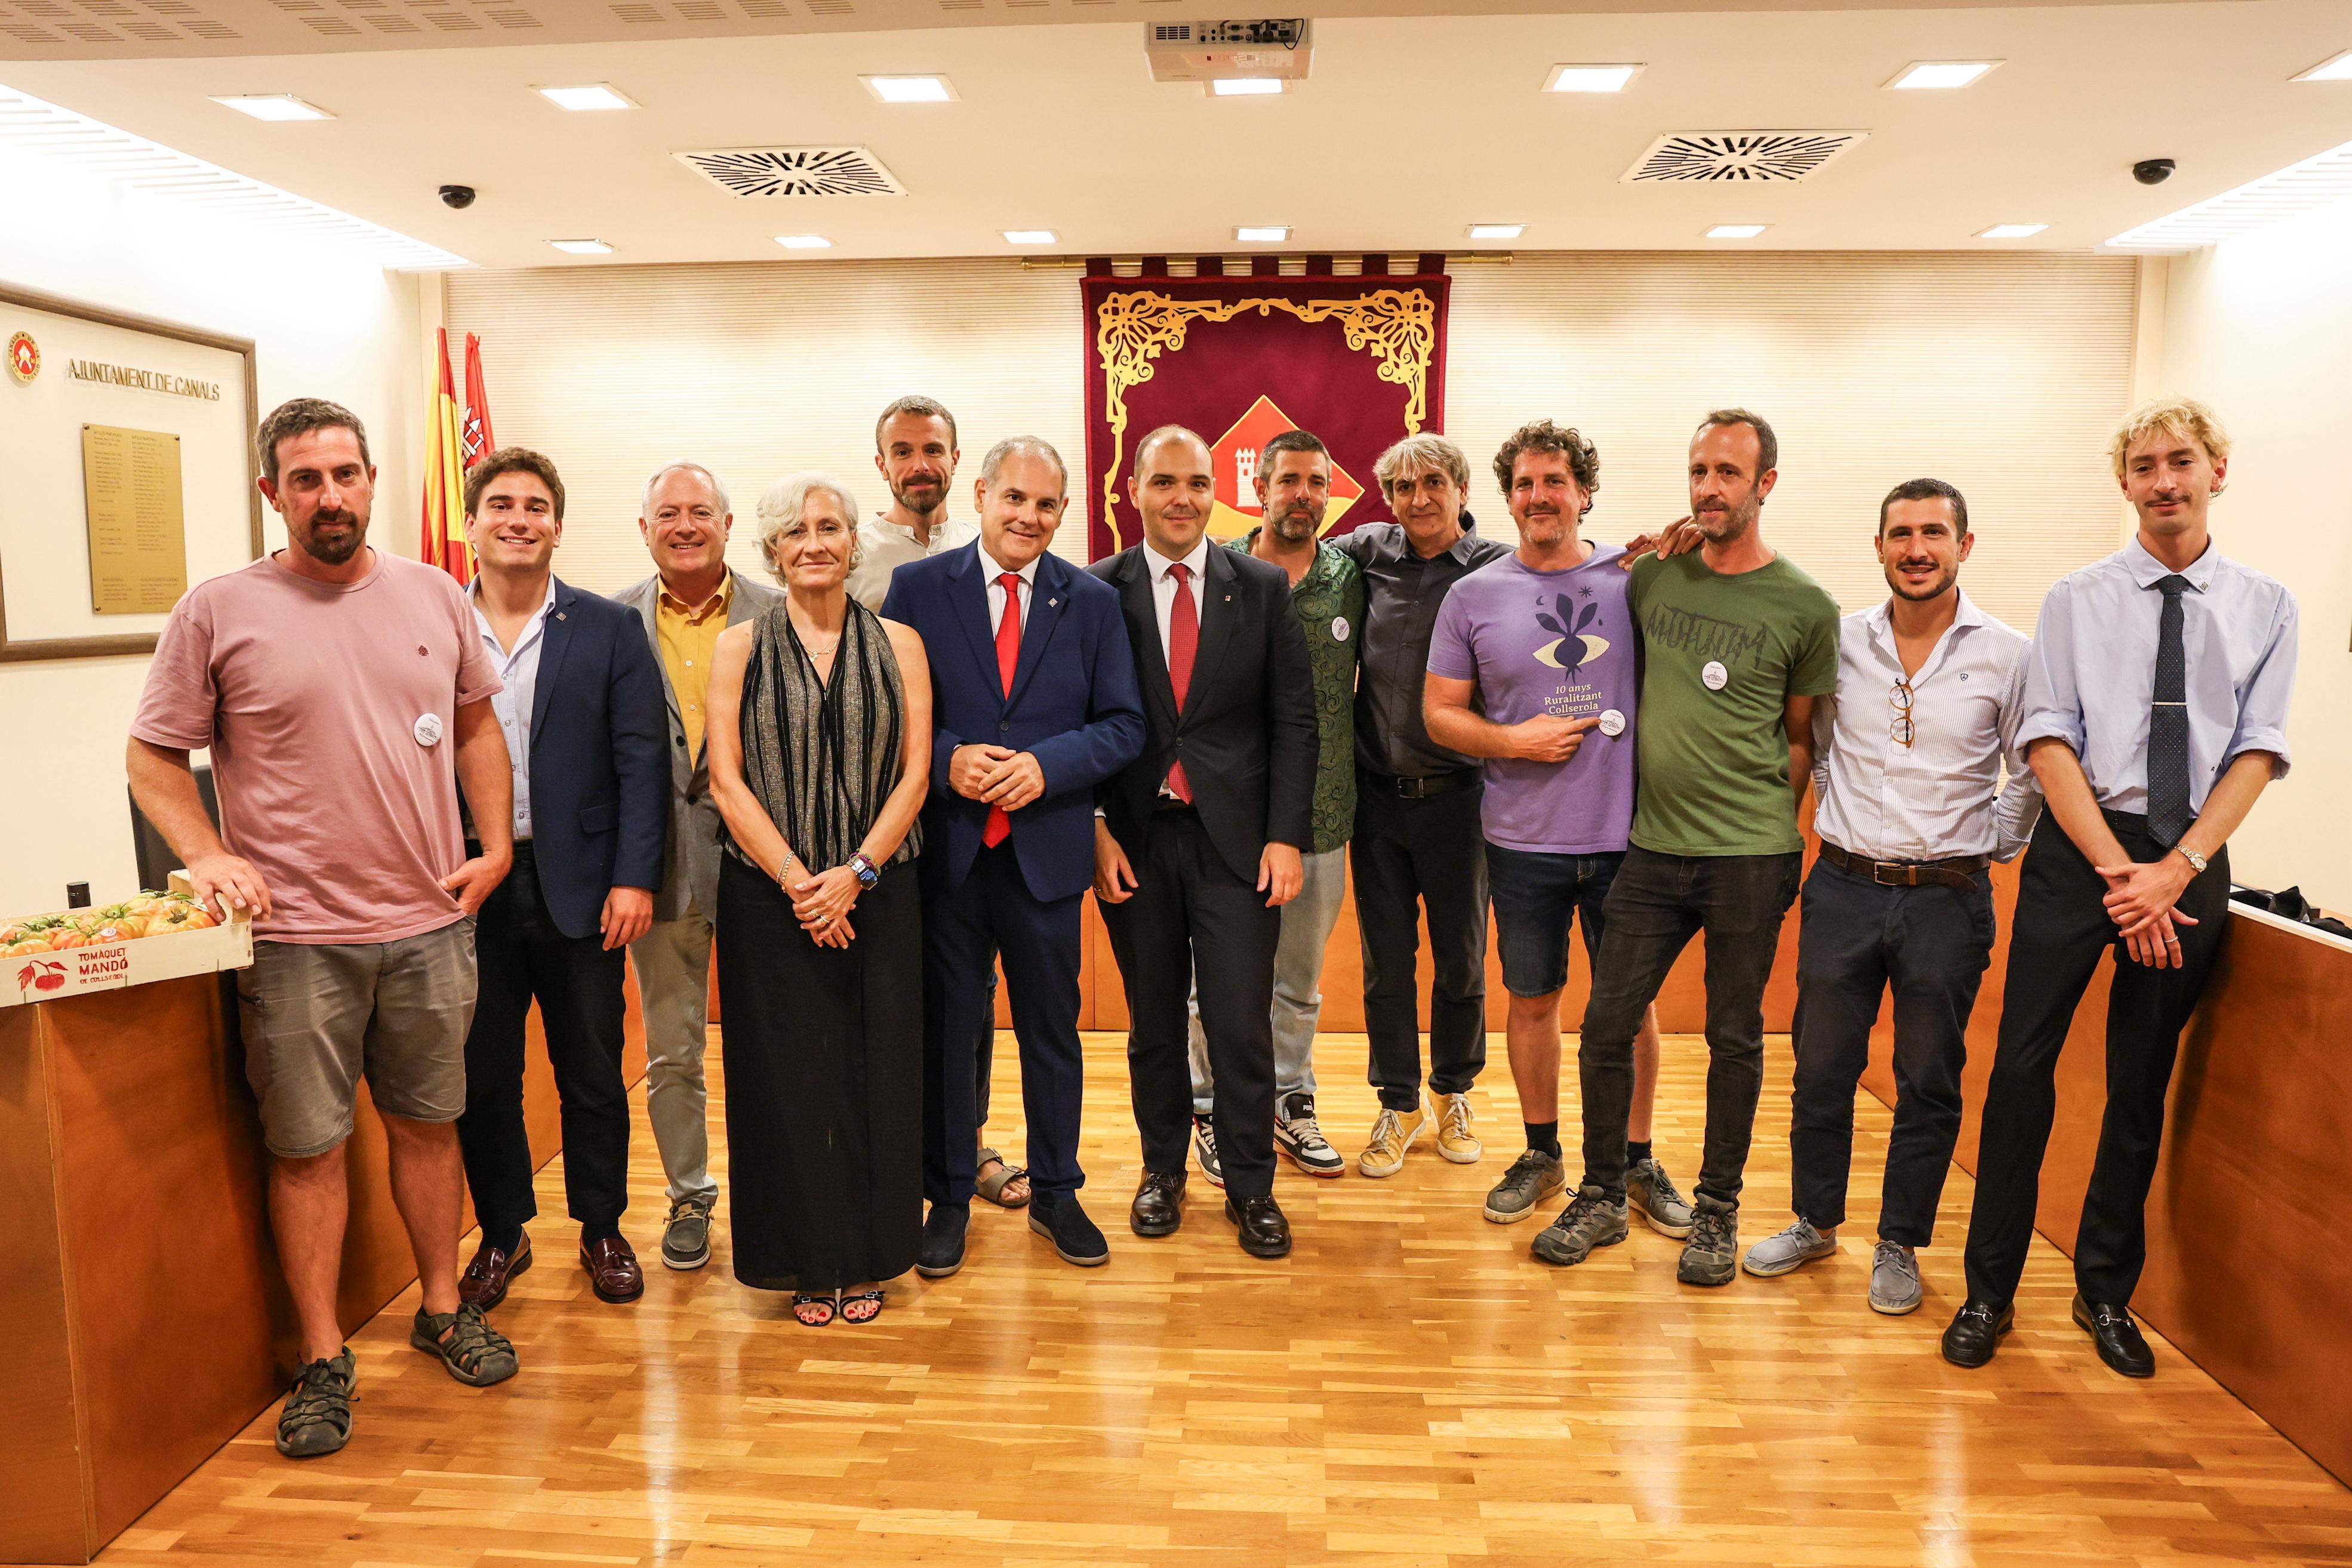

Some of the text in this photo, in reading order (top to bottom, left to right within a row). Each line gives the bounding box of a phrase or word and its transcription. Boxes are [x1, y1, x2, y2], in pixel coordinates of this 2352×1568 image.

[68, 358, 220, 401] AJUNTAMENT DE CANALS
[1556, 684, 1591, 694] 10 anys
[1544, 691, 1602, 705] Ruralitzant
[1548, 701, 1598, 714] Collserola
[79, 956, 128, 975] MANDÓ
